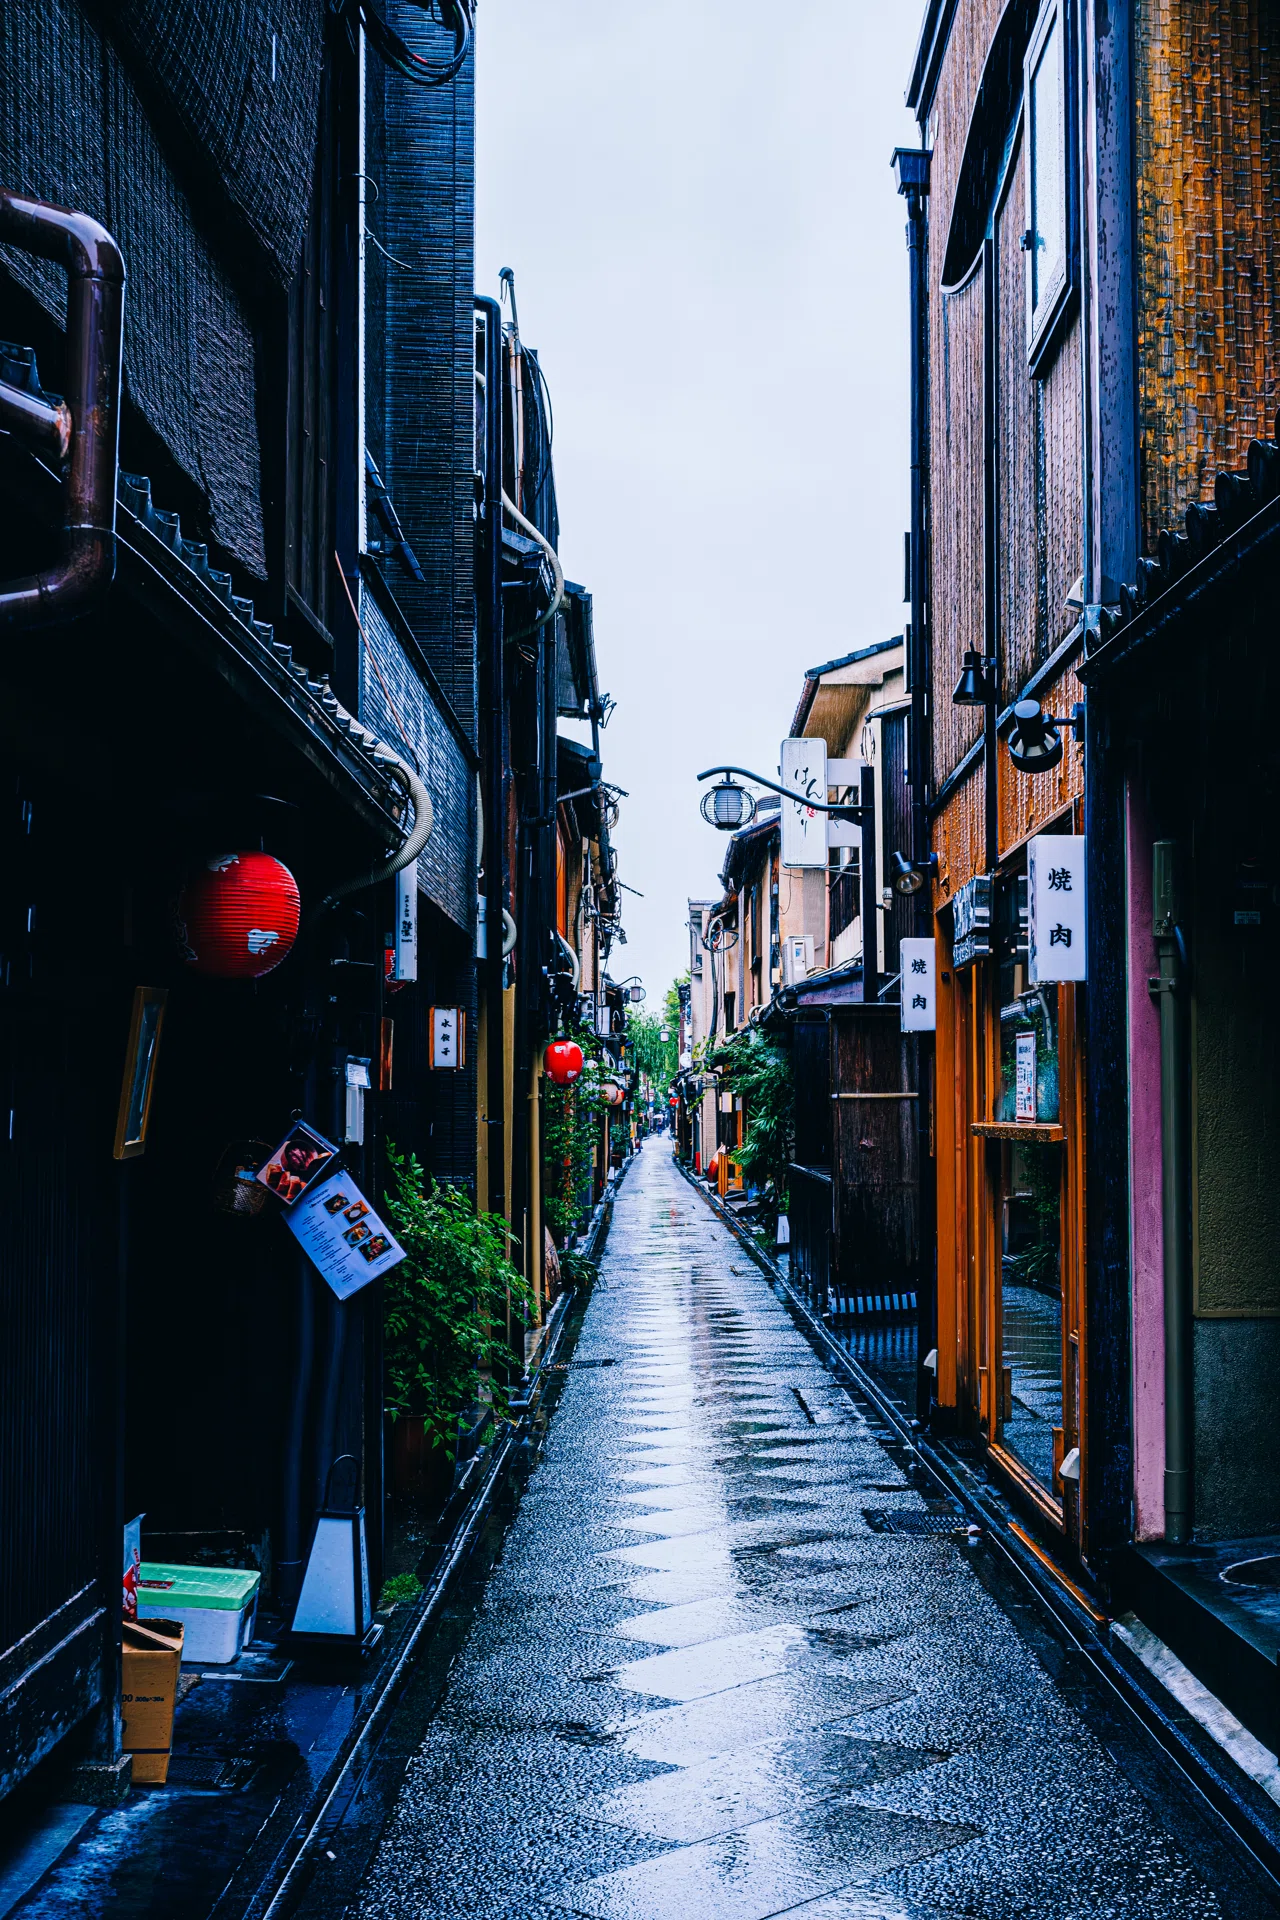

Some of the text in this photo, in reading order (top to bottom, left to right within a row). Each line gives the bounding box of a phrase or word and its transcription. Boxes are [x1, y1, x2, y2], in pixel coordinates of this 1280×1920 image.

[1048, 868, 1073, 948] 焼肉
[911, 958, 927, 1010] 焼肉
[440, 1018, 452, 1056] 水餃子
